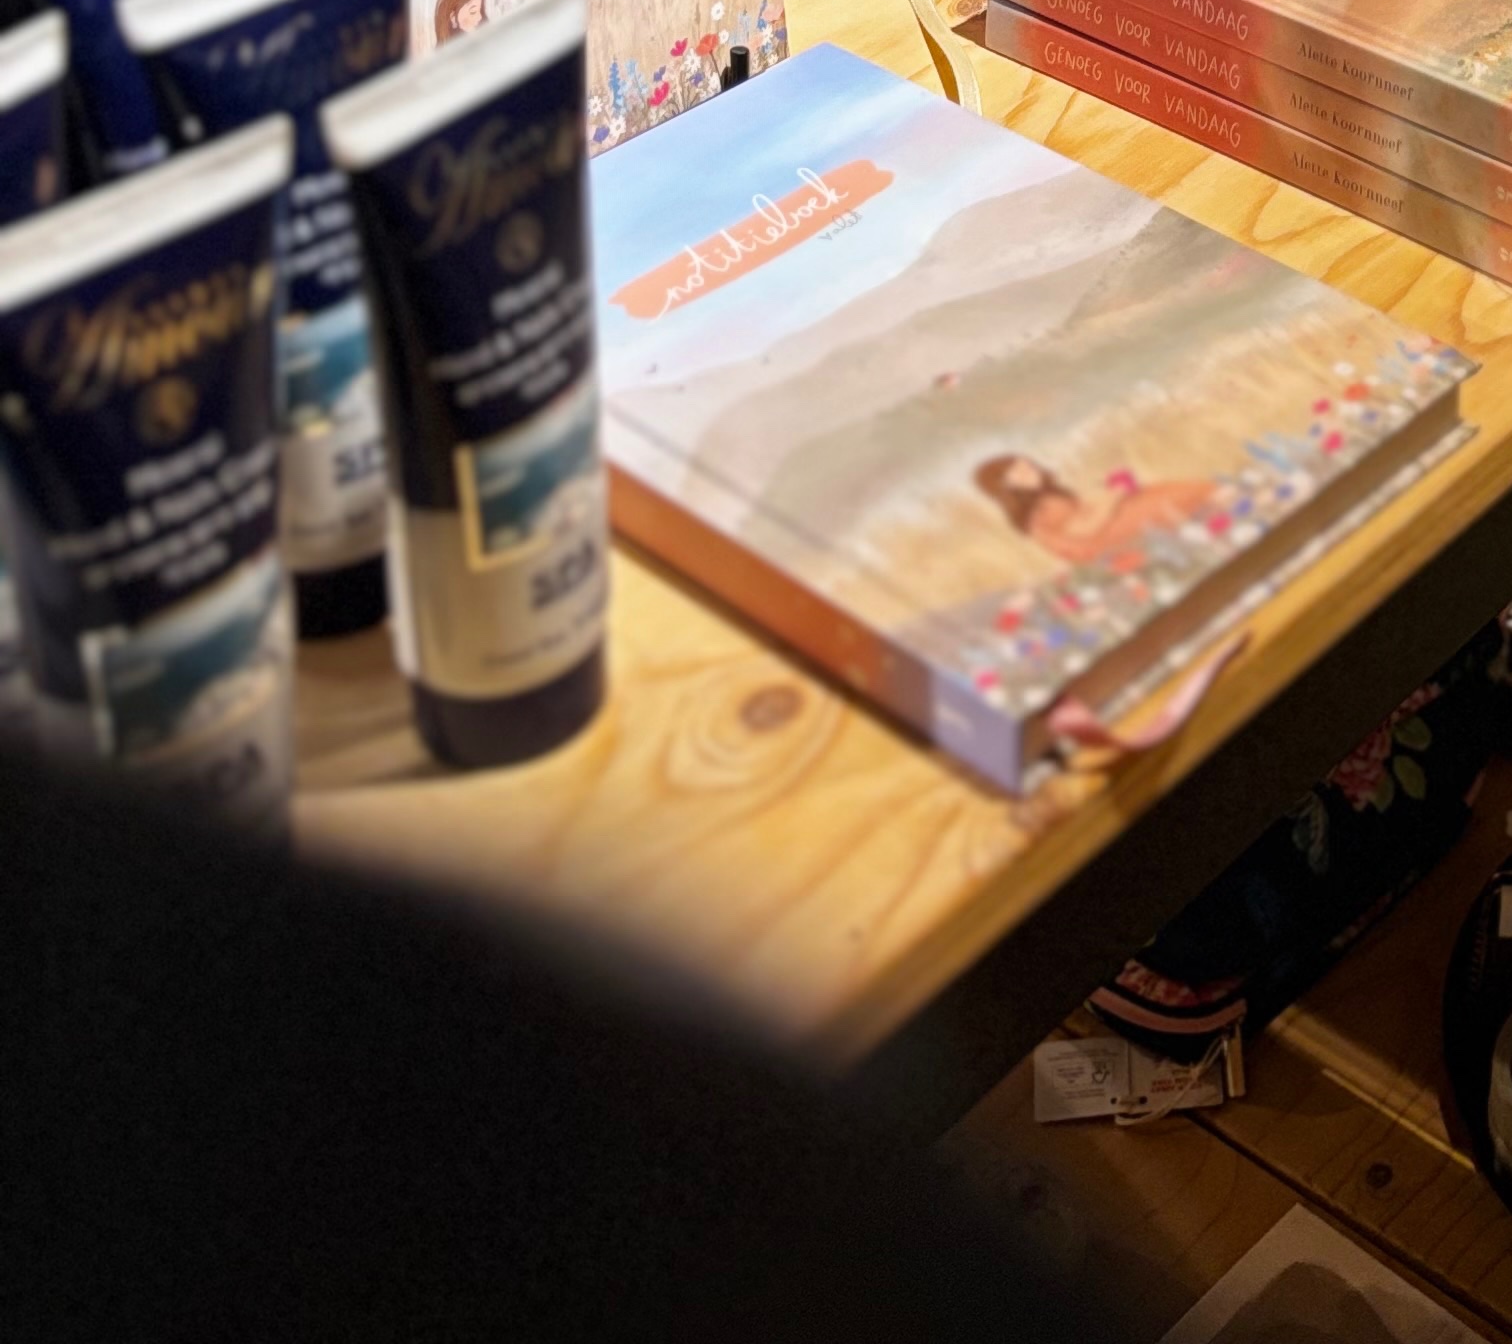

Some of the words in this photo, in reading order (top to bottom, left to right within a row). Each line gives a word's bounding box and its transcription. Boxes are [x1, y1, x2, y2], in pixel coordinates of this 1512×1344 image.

[1044, 41, 1102, 81] GENOEG
[1114, 69, 1150, 104] VOOR
[1164, 91, 1241, 148] VANDAAG
[1292, 151, 1329, 178] Alette
[1333, 170, 1405, 214] Koornneef
[1115, 11, 1151, 47] VOOR
[1165, 33, 1241, 90] VANDAAG
[1289, 92, 1328, 121] Alette
[1332, 111, 1402, 155] Koornneef
[1297, 42, 1338, 69] Alette
[1342, 59, 1414, 102] Koornneef
[656, 167, 849, 321] notitieboek
